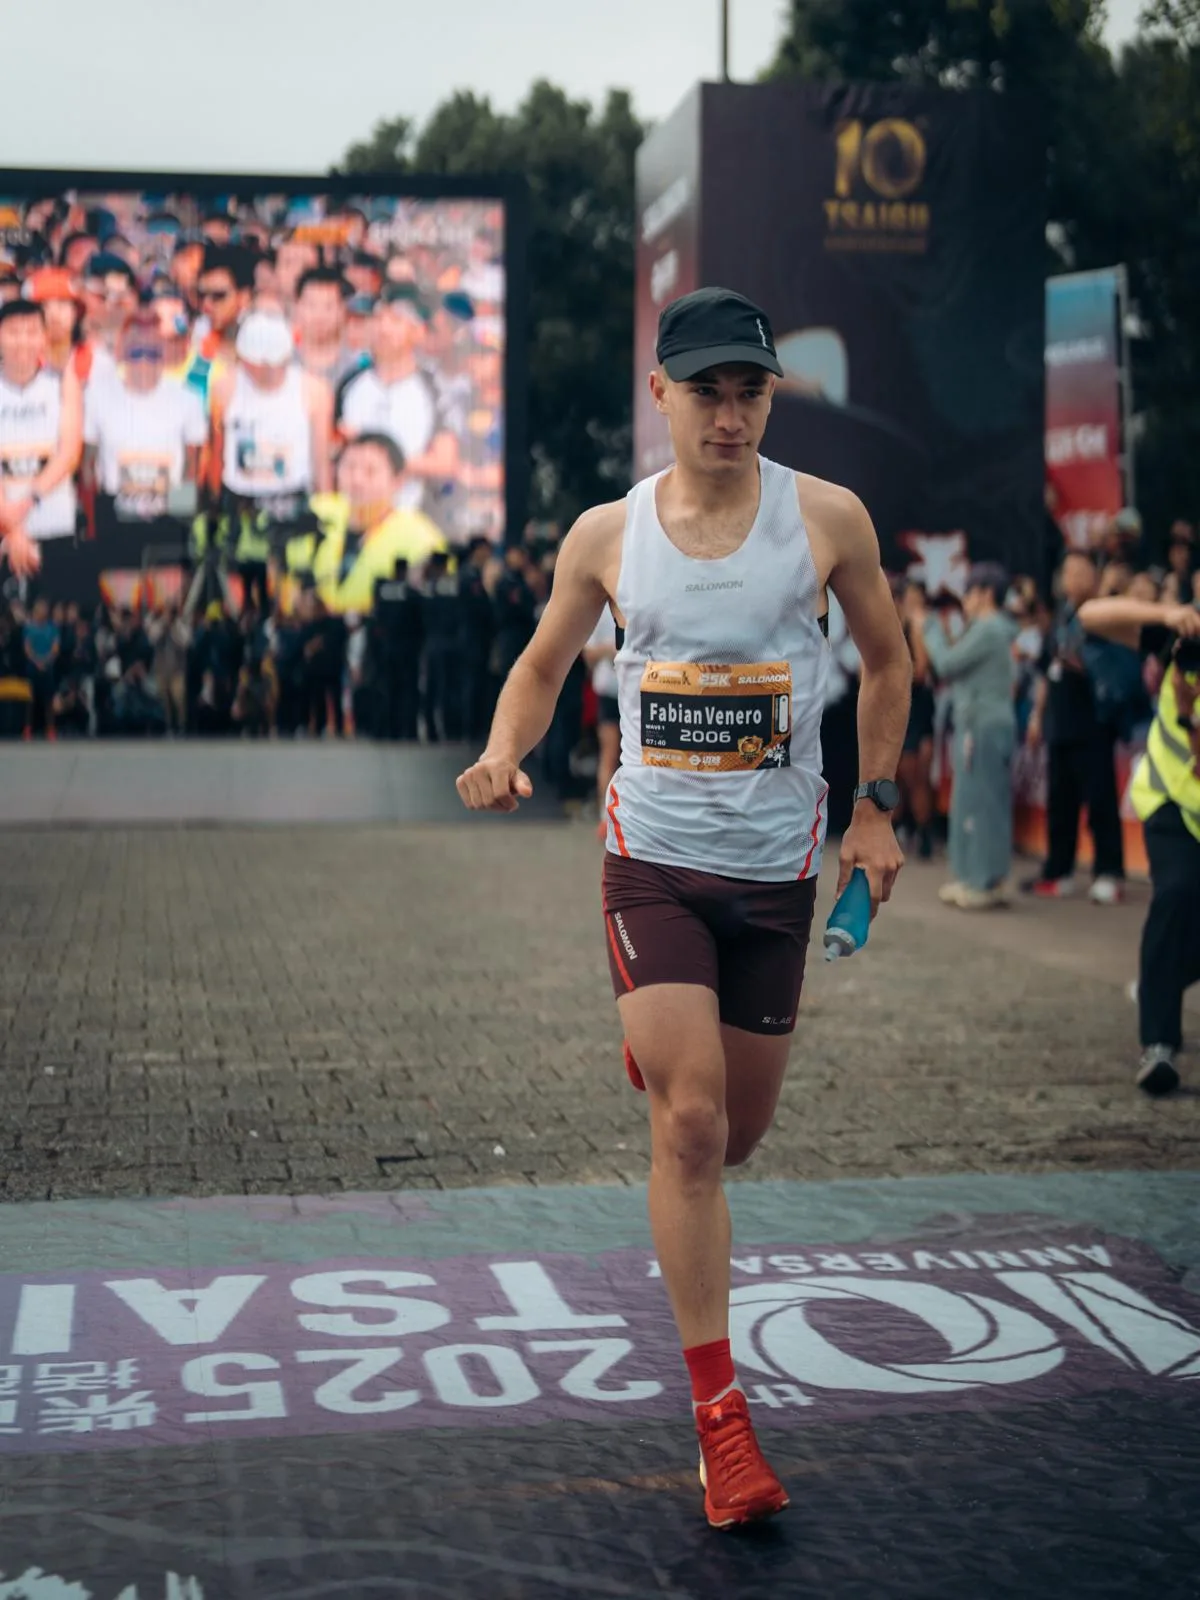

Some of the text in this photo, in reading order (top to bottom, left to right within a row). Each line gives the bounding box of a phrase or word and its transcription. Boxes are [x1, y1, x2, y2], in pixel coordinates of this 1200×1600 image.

[834, 117, 927, 199] 10
[684, 580, 744, 592] SALOMON
[738, 674, 789, 685] SALOMON
[649, 702, 763, 725] Fabian Venero
[645, 738, 667, 746] 07:40
[680, 729, 731, 744] 2006
[615, 911, 638, 960] SALOMON
[12, 1260, 628, 1355] TSAI
[183, 1338, 664, 1423] 2025
